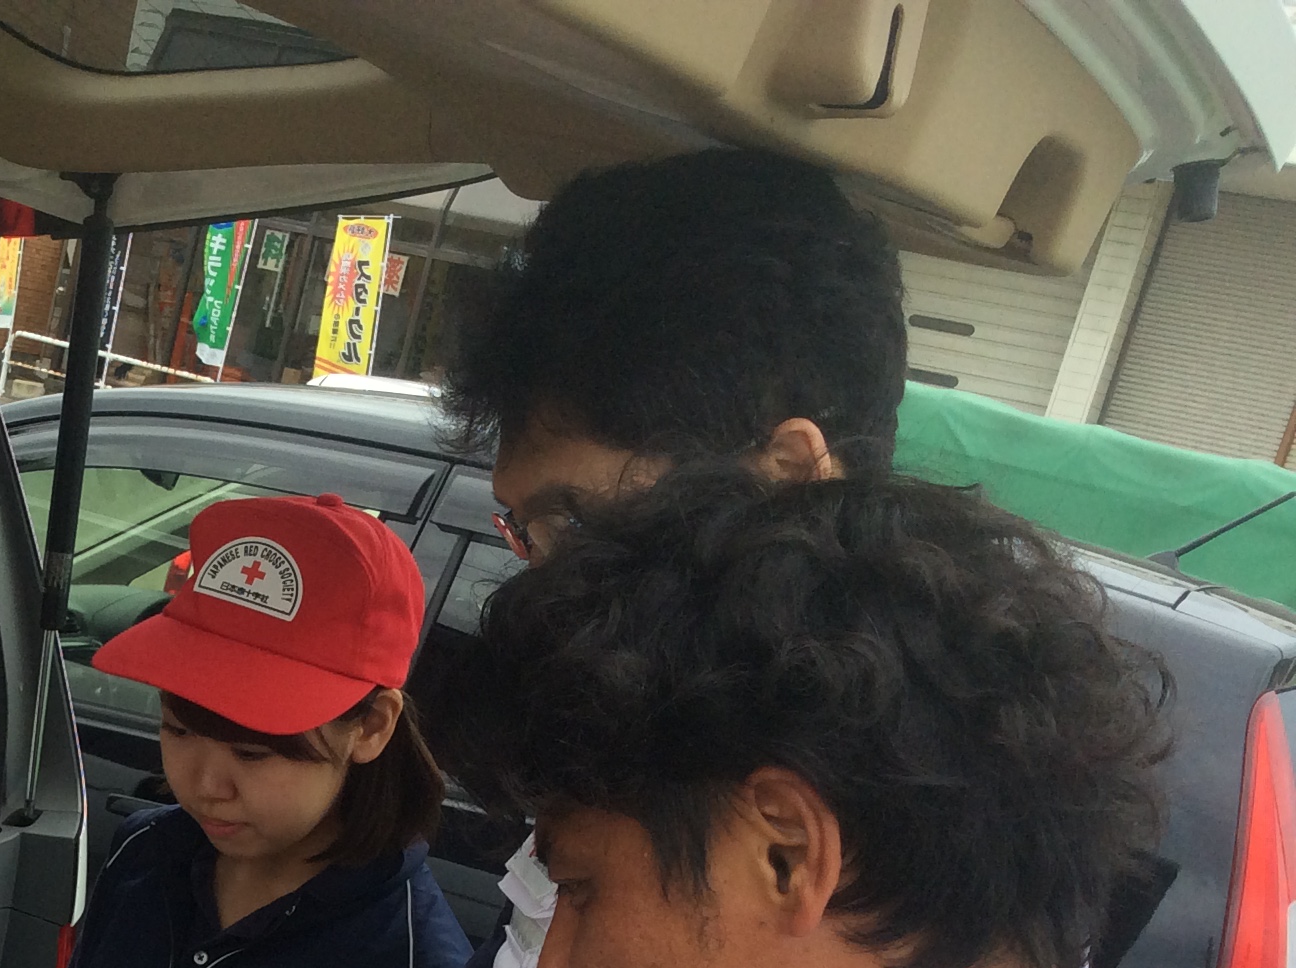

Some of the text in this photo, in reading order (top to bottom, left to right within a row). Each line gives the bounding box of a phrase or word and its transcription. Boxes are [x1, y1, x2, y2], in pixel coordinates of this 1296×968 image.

[207, 545, 295, 603] JAPANESE RED CROSS SOCIETY
